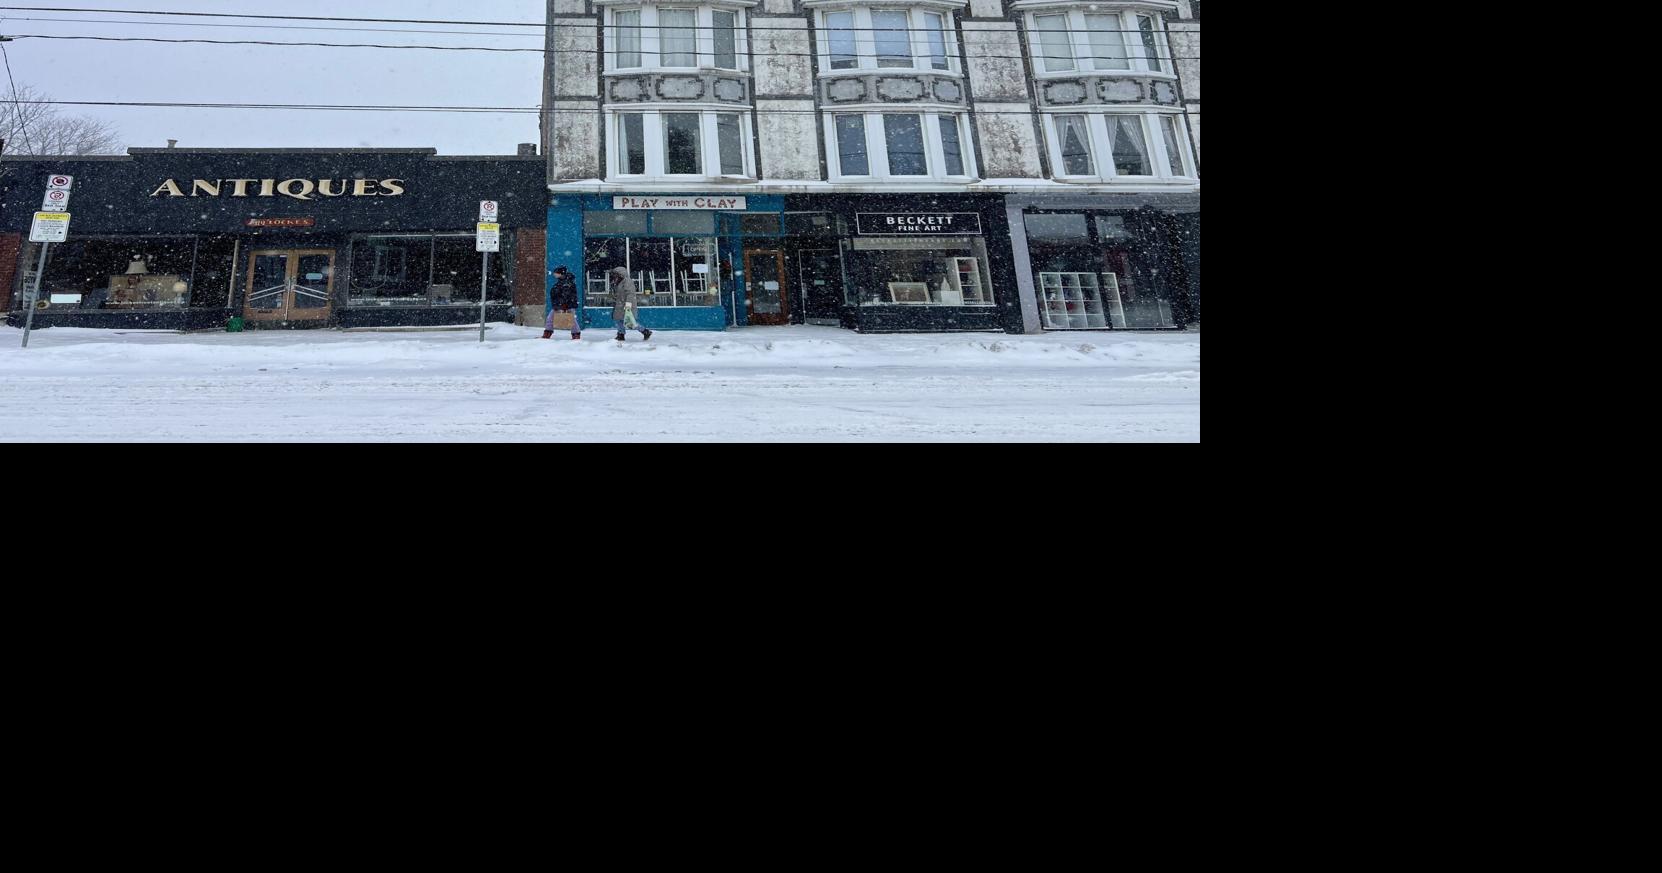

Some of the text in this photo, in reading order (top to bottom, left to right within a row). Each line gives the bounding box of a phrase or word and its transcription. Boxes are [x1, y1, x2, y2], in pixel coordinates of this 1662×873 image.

[150, 178, 405, 200] ANTIQUES
[621, 197, 737, 208] PLAY WITH CLAY
[886, 216, 953, 225] BECKETT
